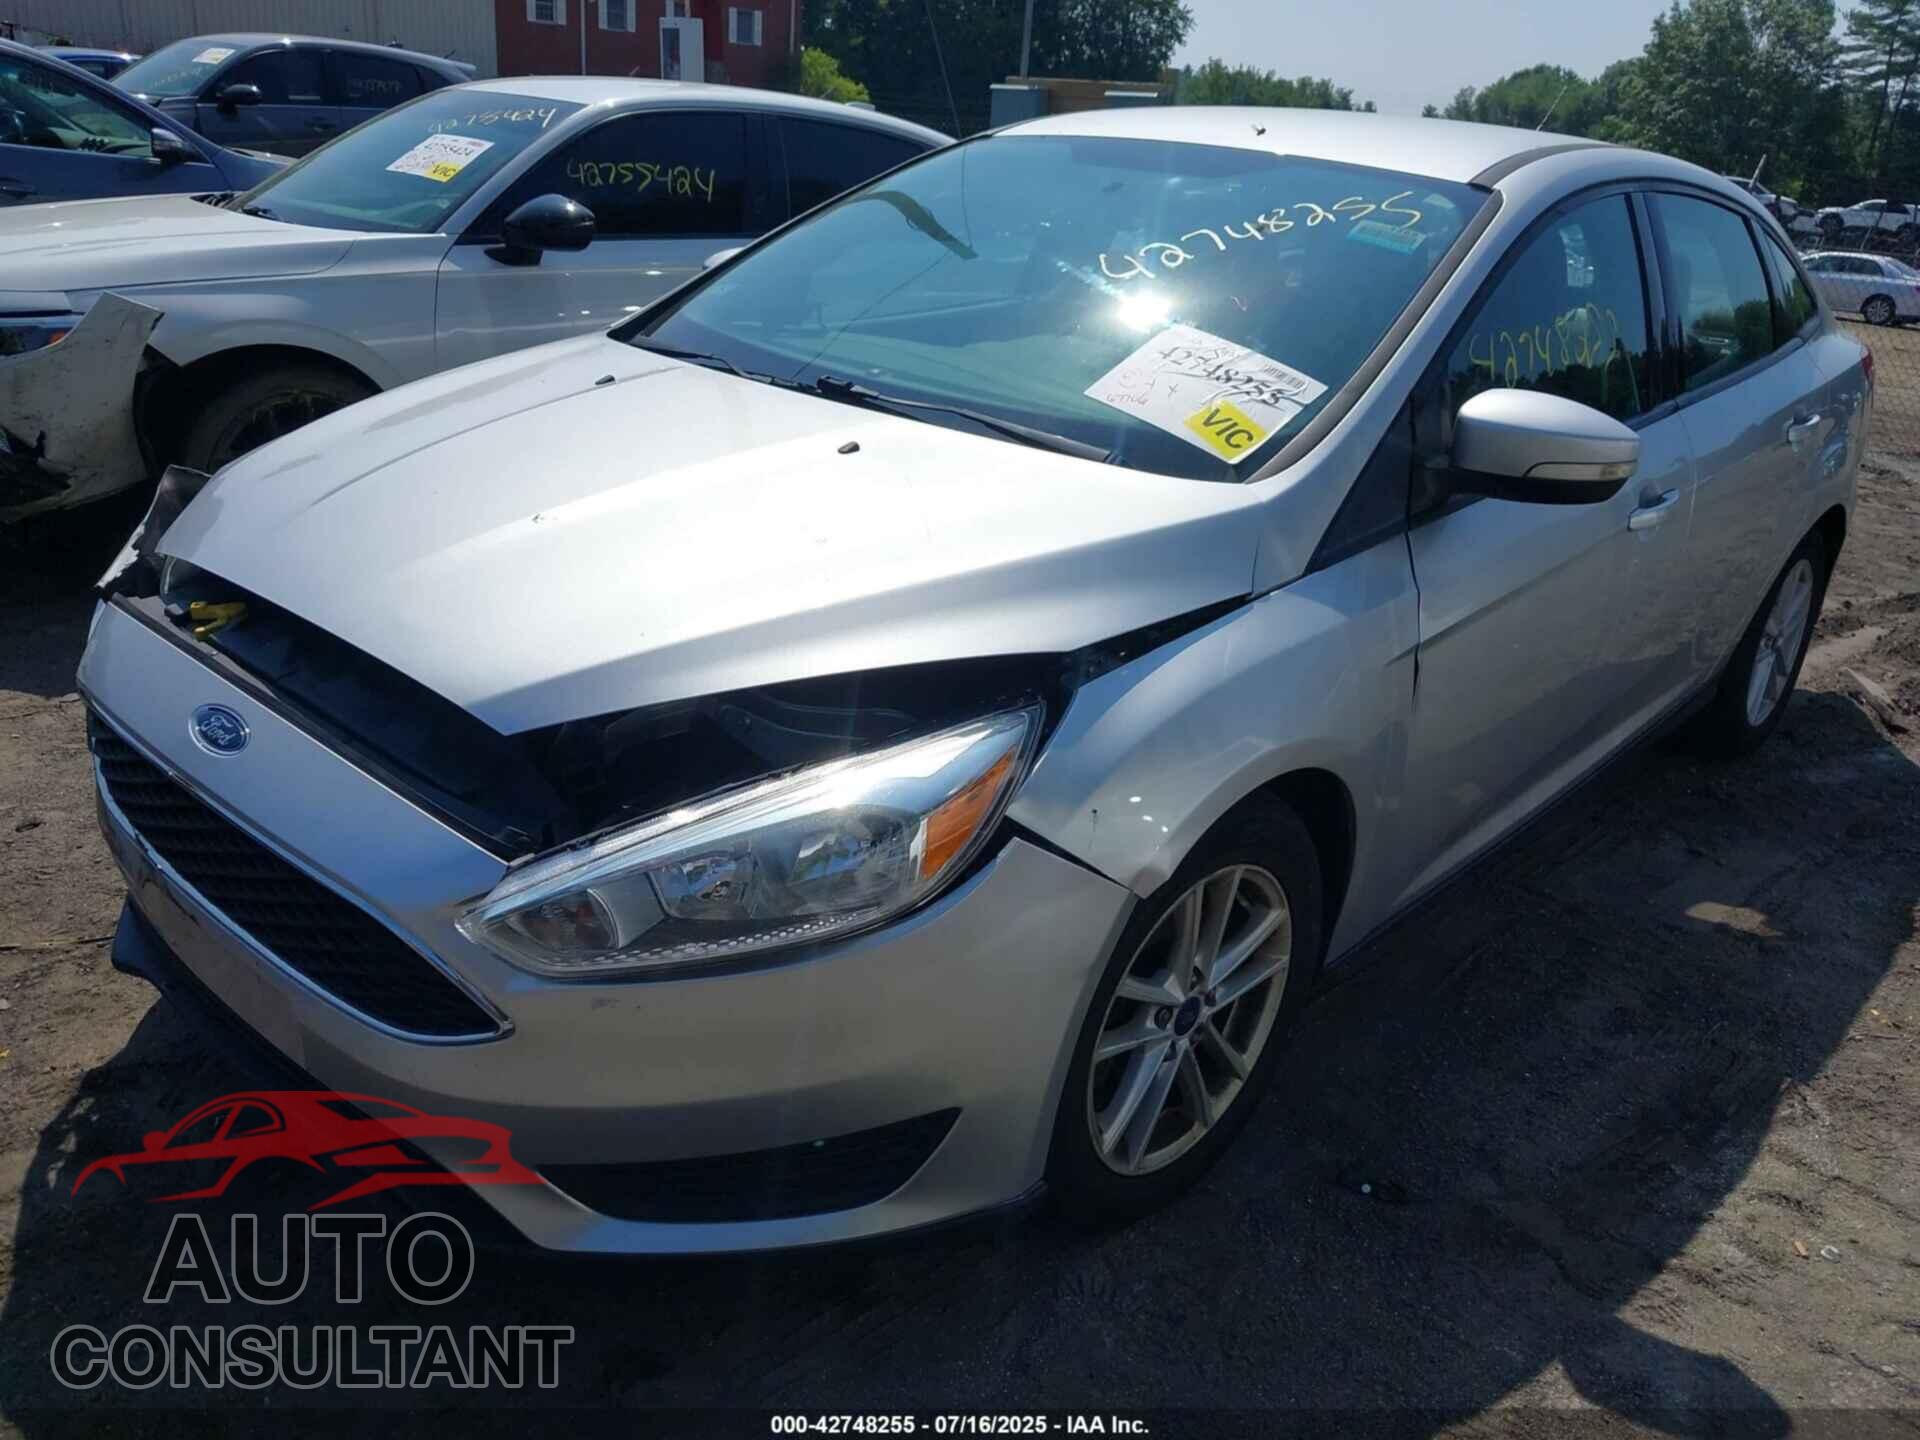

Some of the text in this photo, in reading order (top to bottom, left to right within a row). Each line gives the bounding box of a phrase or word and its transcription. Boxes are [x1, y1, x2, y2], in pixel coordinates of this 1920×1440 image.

[566, 158, 716, 203] 42755424
[1099, 190, 1422, 280] 42748255
[1202, 408, 1254, 450] VIC
[200, 714, 237, 746] Ford
